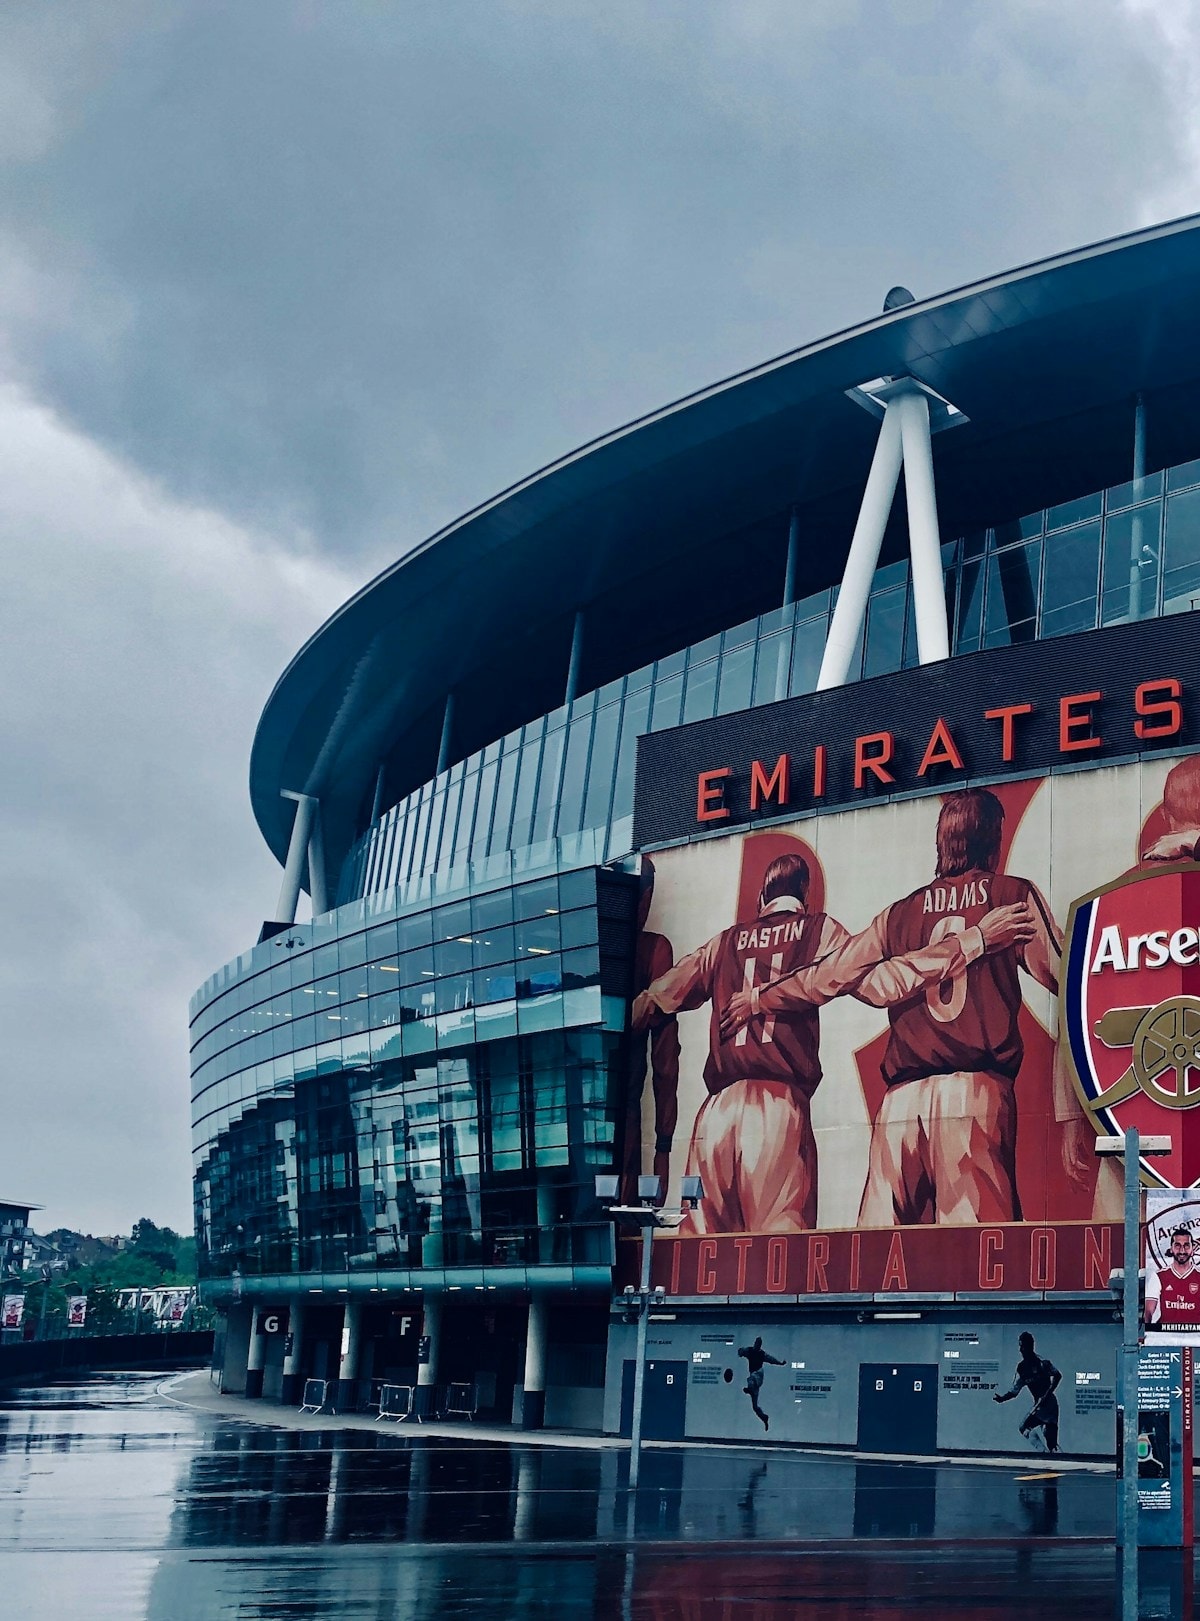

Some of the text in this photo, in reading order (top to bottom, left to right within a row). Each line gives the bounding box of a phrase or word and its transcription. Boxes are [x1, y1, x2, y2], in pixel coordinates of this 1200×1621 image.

[696, 677, 1184, 822] EMIRATES
[923, 878, 990, 915] ADAMS
[737, 919, 805, 951] BASTIN
[734, 952, 784, 1048] 11
[264, 1316, 279, 1332] G
[400, 1316, 412, 1336] F
